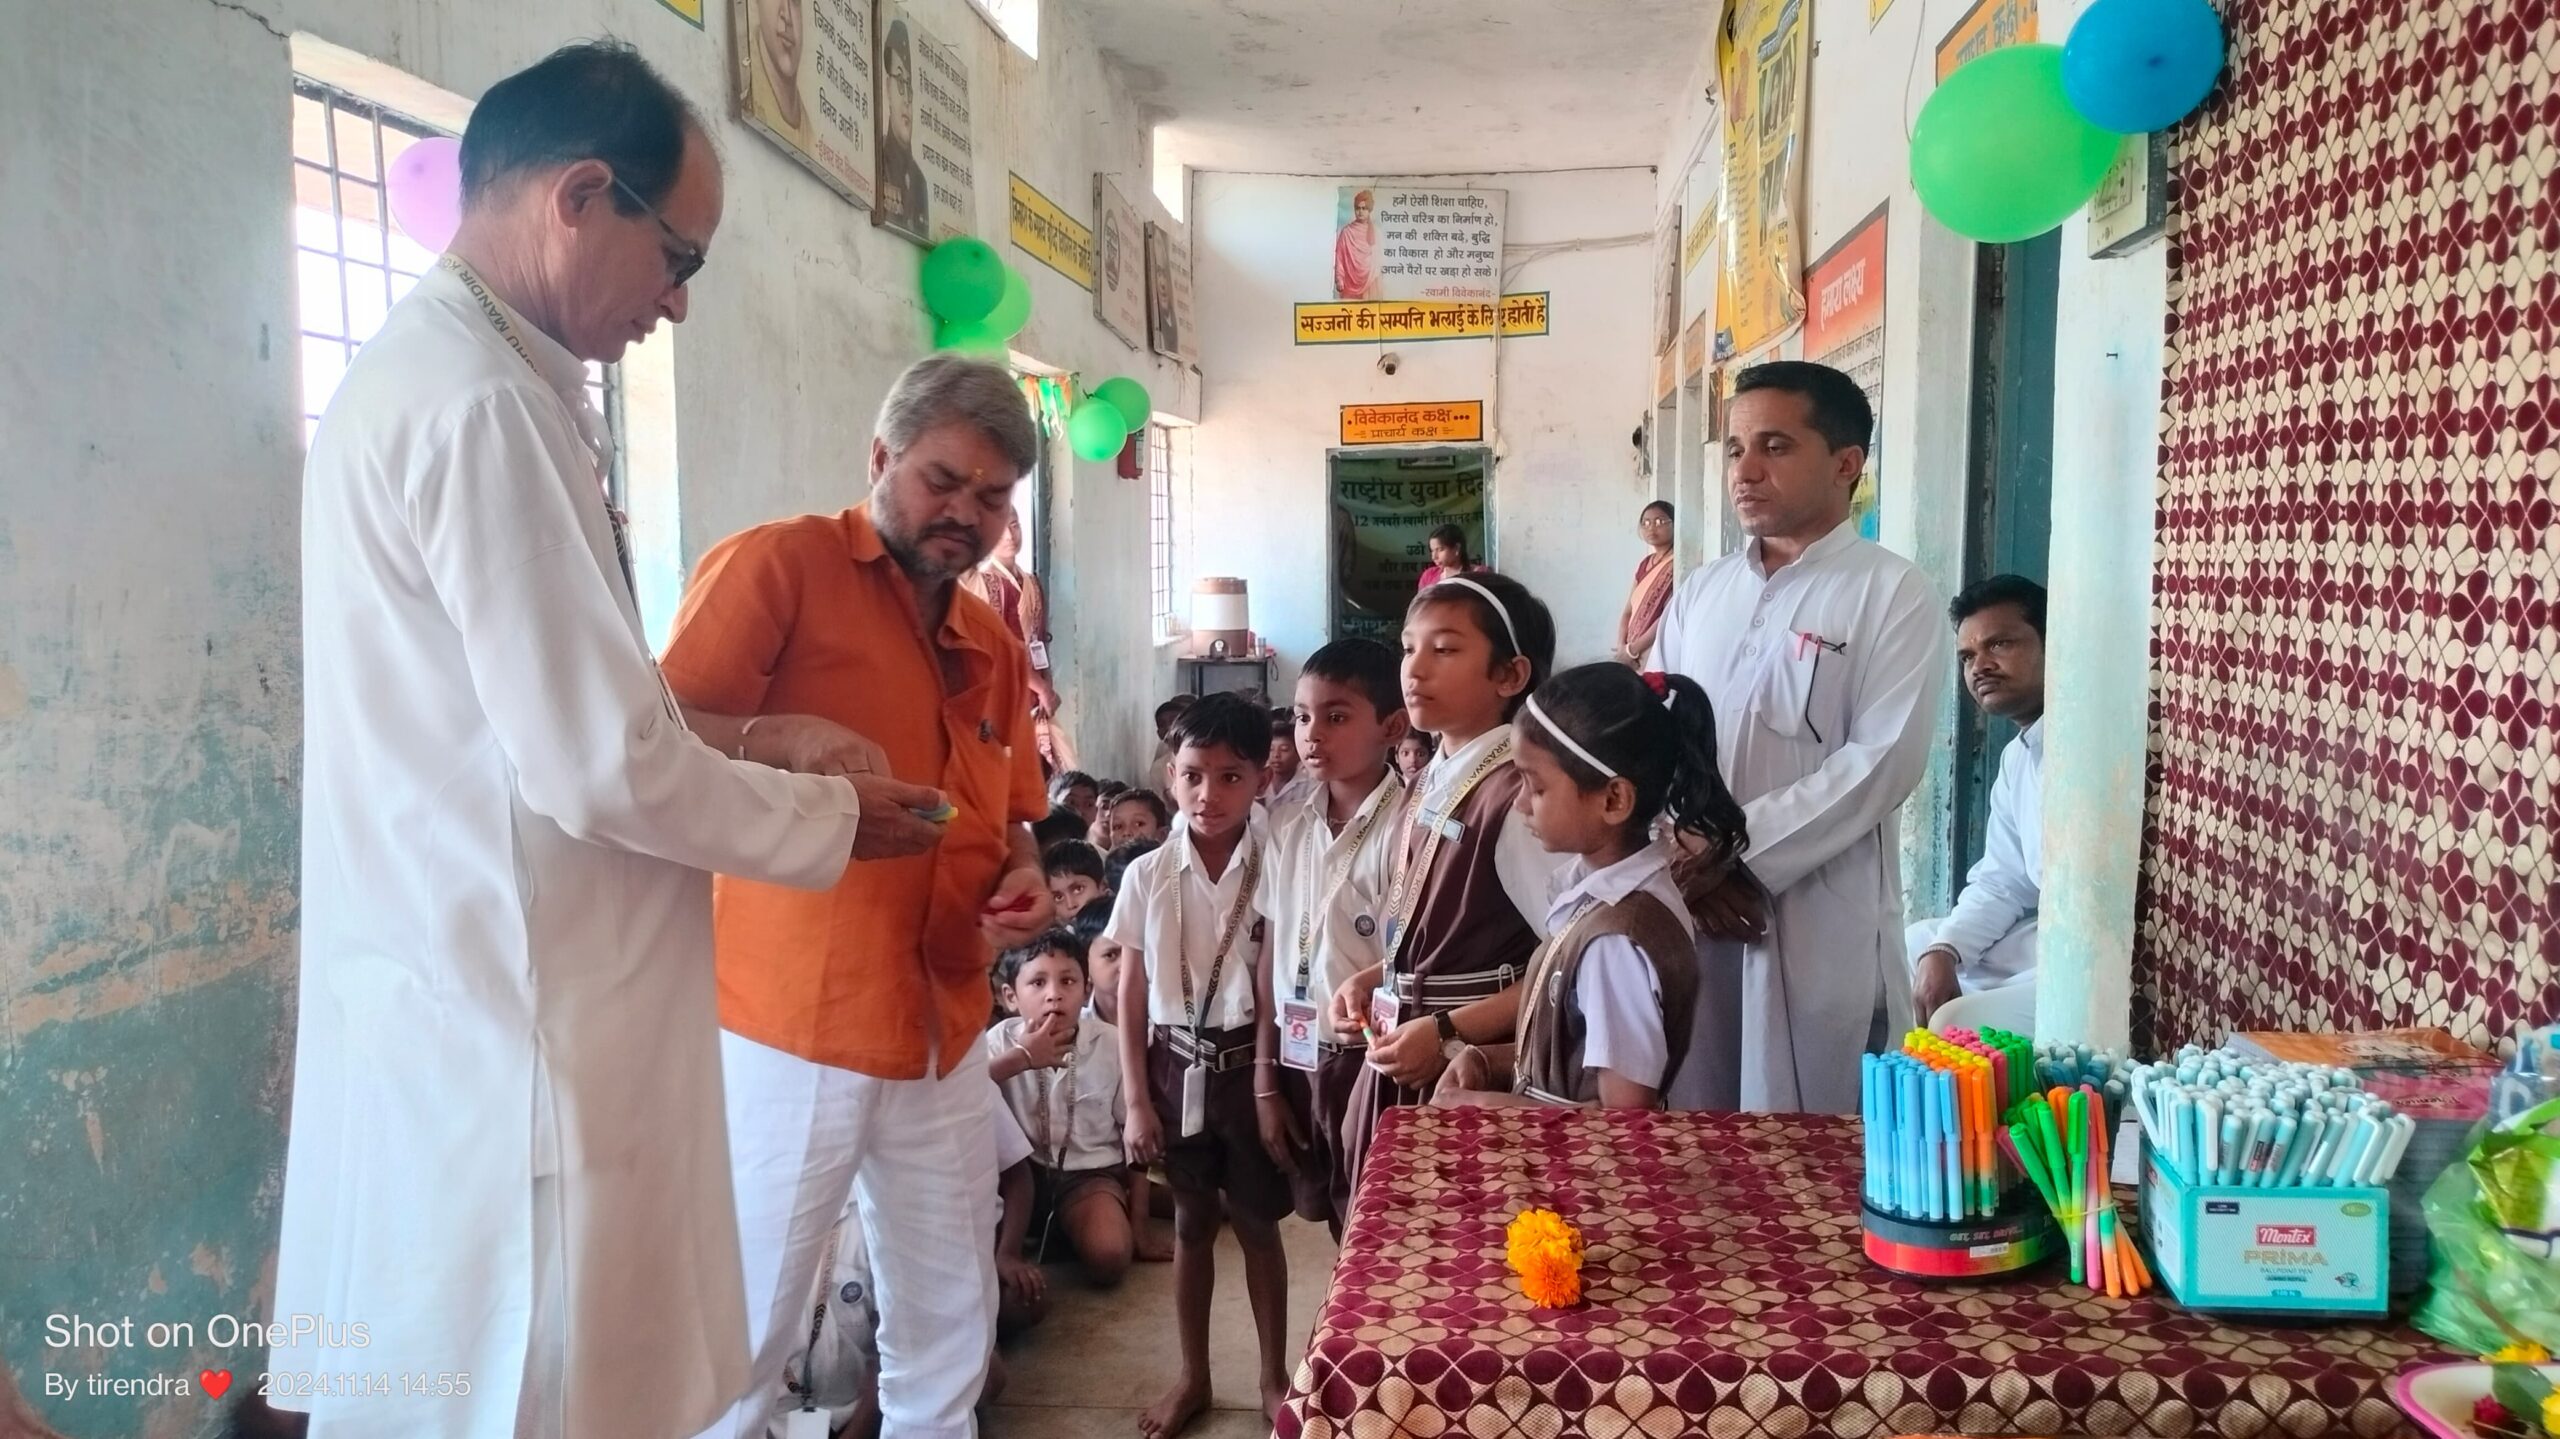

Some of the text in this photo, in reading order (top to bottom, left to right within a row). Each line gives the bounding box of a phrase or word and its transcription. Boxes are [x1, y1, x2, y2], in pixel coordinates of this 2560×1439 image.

[1392, 193, 1408, 208] हमें
[1410, 194, 1430, 208] ऐसी
[1431, 194, 1455, 208] शिक्षा
[1380, 211, 1409, 224] जिससे
[1437, 214, 1451, 225] का
[1452, 211, 1482, 226] निर्माण
[1386, 231, 1402, 241] मन
[1404, 228, 1417, 241] की
[1383, 246, 1495, 264] का विकास हो और मनुष्य
[1381, 263, 1405, 276] अपने
[1425, 266, 1438, 277] पर
[1461, 264, 1472, 278] हो
[1843, 256, 1865, 306] लक्ष्य
[459, 269, 510, 333] MANDIR
[1301, 307, 1353, 333] सज्जनों
[1356, 307, 1377, 332] की
[1430, 302, 1465, 334] भलाई
[1467, 303, 1480, 326] के
[1353, 408, 1452, 426] विवेकानंद कक्ष
[1371, 424, 1438, 439] प्राचार्य कक्ष
[1341, 475, 1403, 505] राष्ट्रीय
[1409, 479, 1450, 508] युवा
[1354, 514, 1369, 527] 12
[2259, 1227, 2312, 1244] Montex
